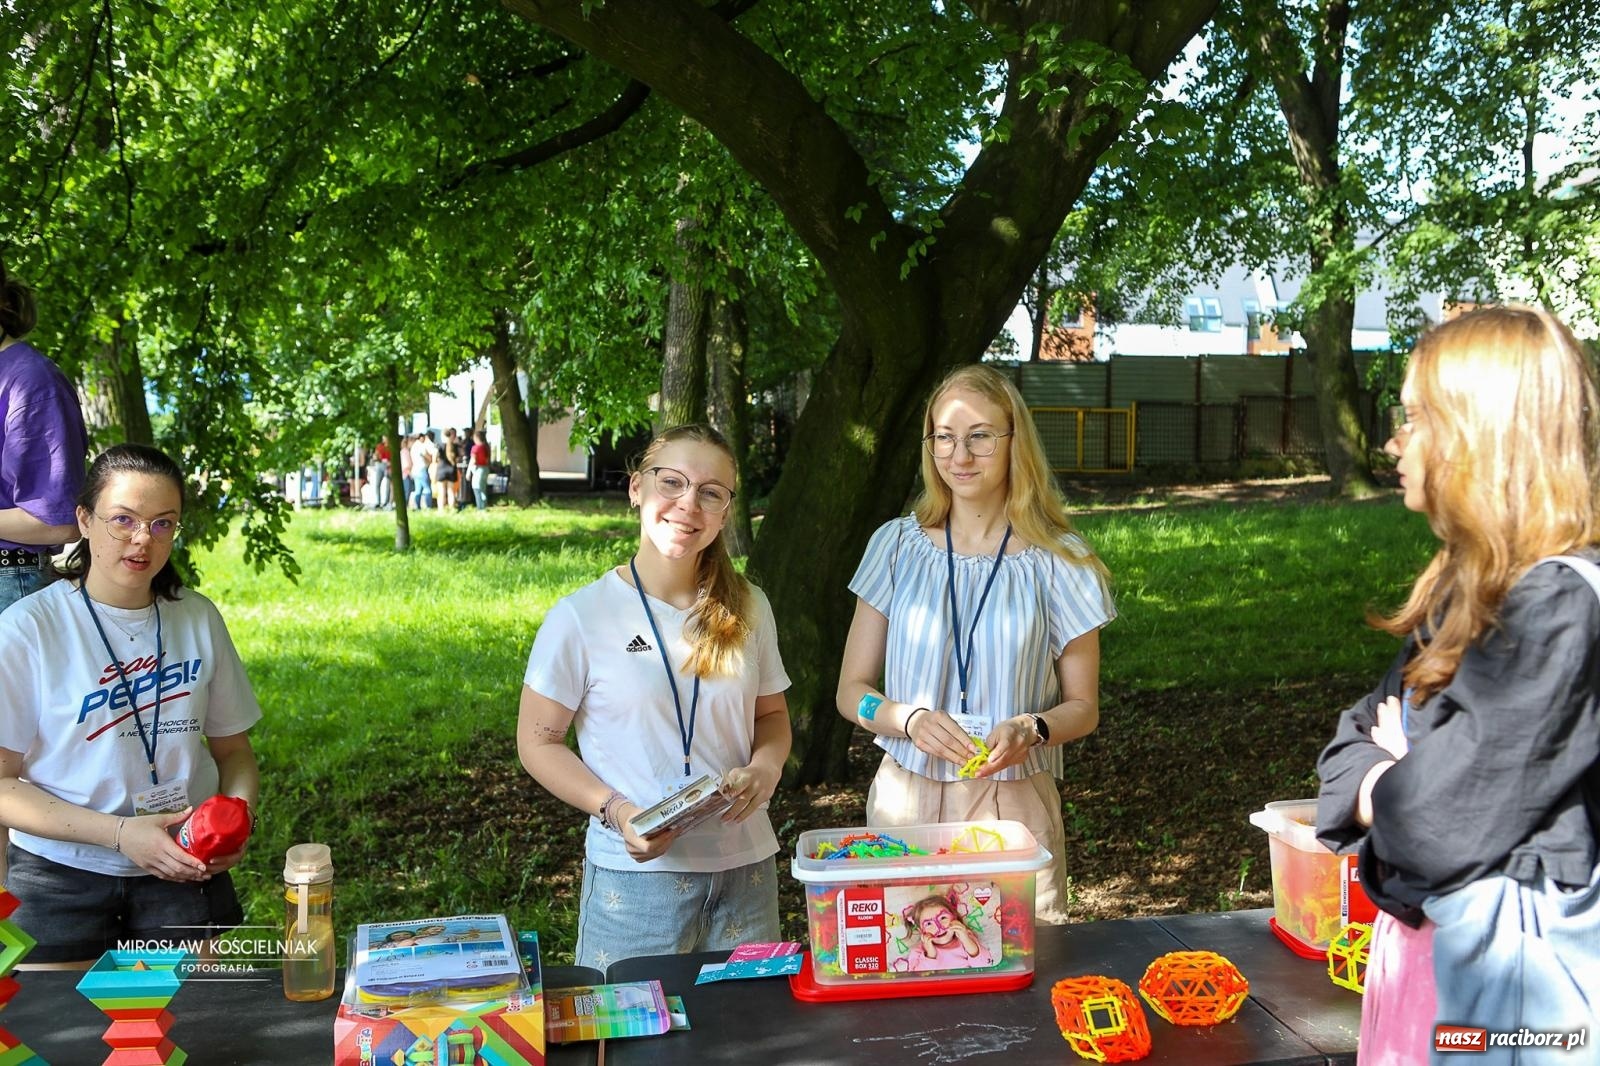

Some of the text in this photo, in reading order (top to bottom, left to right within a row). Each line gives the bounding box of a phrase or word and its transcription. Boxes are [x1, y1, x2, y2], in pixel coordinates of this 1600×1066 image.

[77, 659, 202, 725] PEPSI!
[852, 903, 878, 913] REKO
[854, 956, 879, 964] CLASSIC
